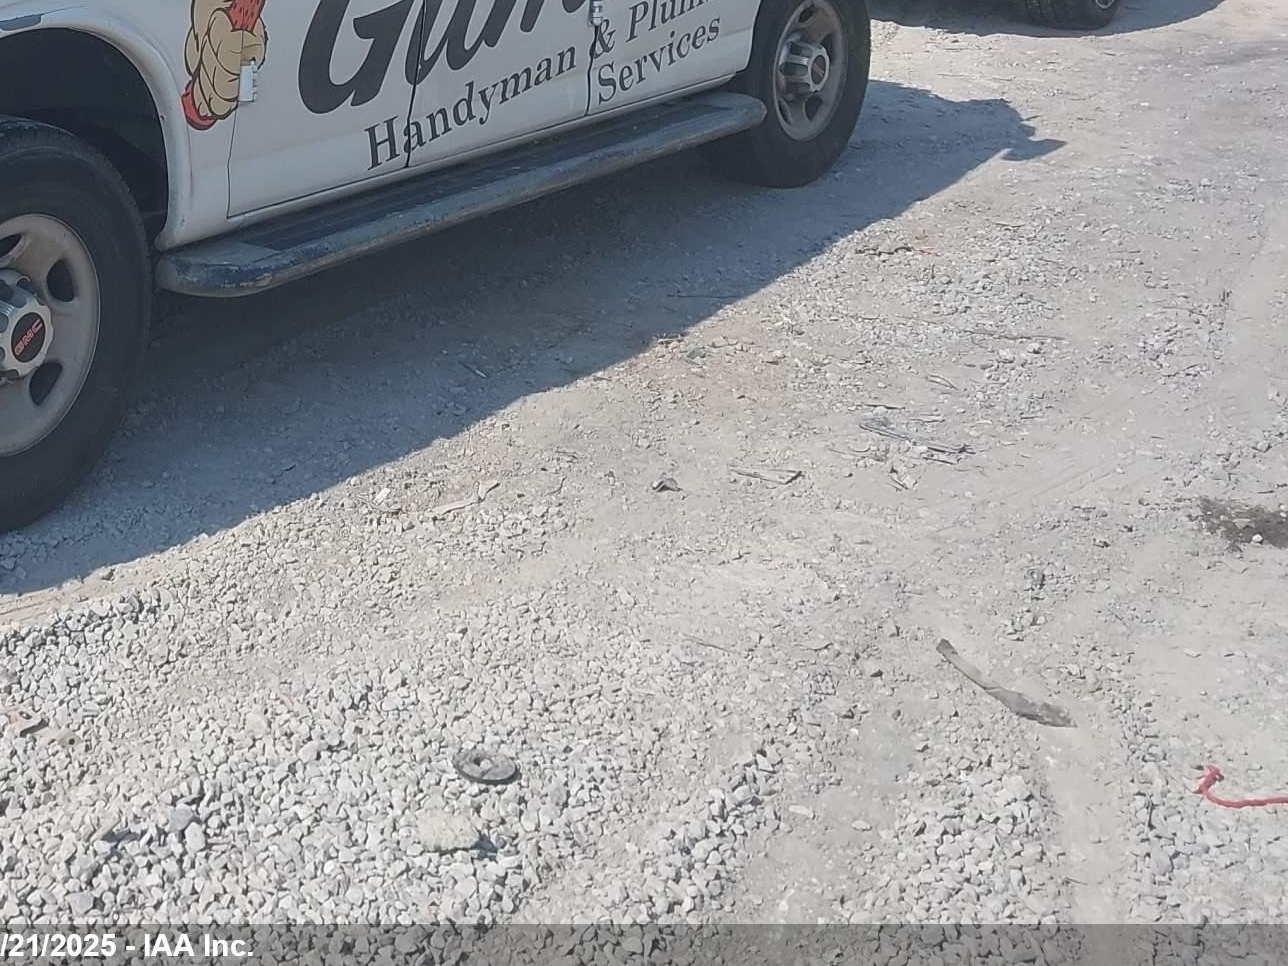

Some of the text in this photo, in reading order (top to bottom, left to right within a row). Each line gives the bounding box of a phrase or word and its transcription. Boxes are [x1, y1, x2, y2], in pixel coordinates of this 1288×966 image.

[364, 43, 576, 170] Handyman
[589, 20, 616, 58] &
[598, 16, 720, 105] Services
[14, 318, 43, 355] GMC
